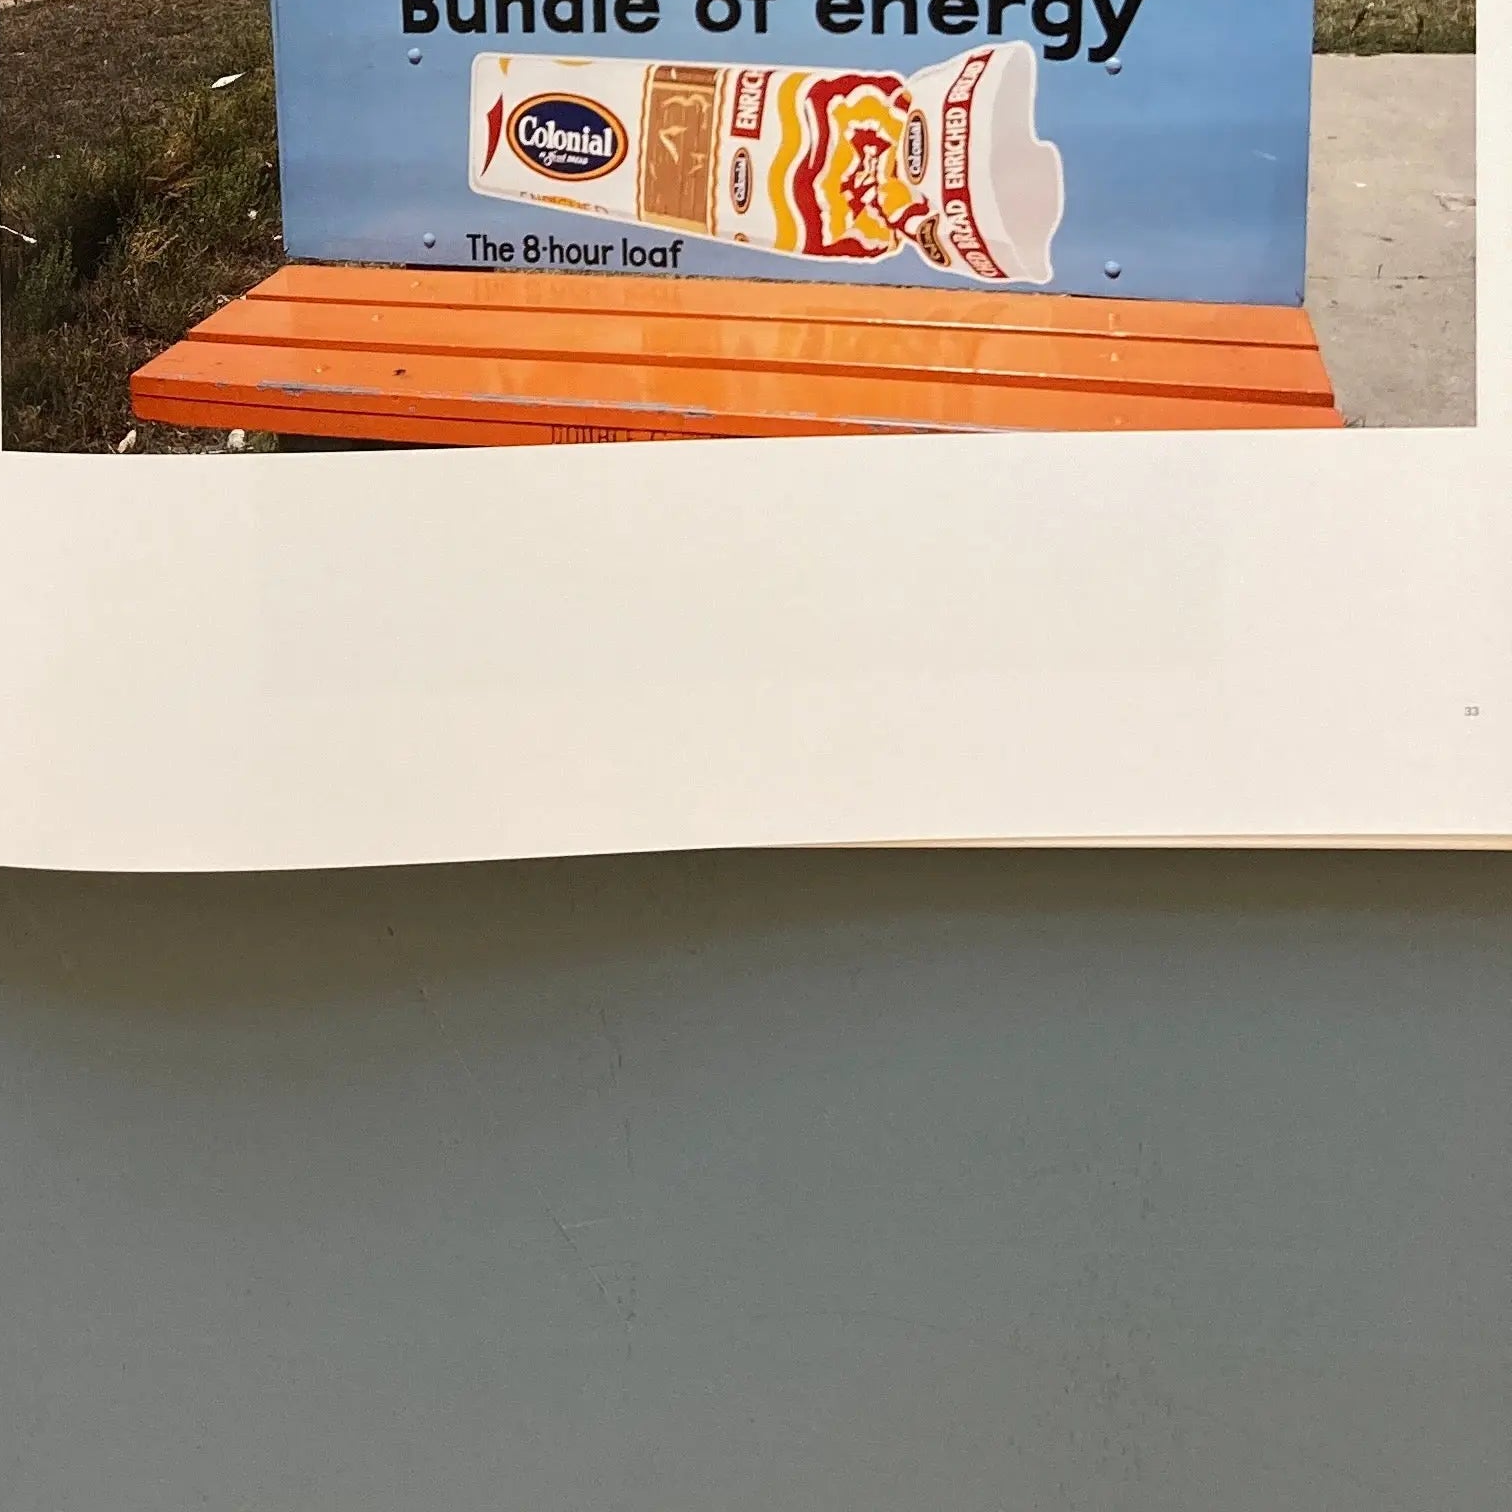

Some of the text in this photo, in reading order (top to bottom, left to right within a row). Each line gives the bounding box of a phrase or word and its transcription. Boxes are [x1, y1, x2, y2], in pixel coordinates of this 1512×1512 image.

[734, 70, 765, 130] ENRIC
[518, 114, 614, 158] Colonial
[943, 105, 969, 190] ENRICHED
[465, 233, 515, 265] The
[621, 236, 684, 269] loaf
[1464, 706, 1479, 717] 33
